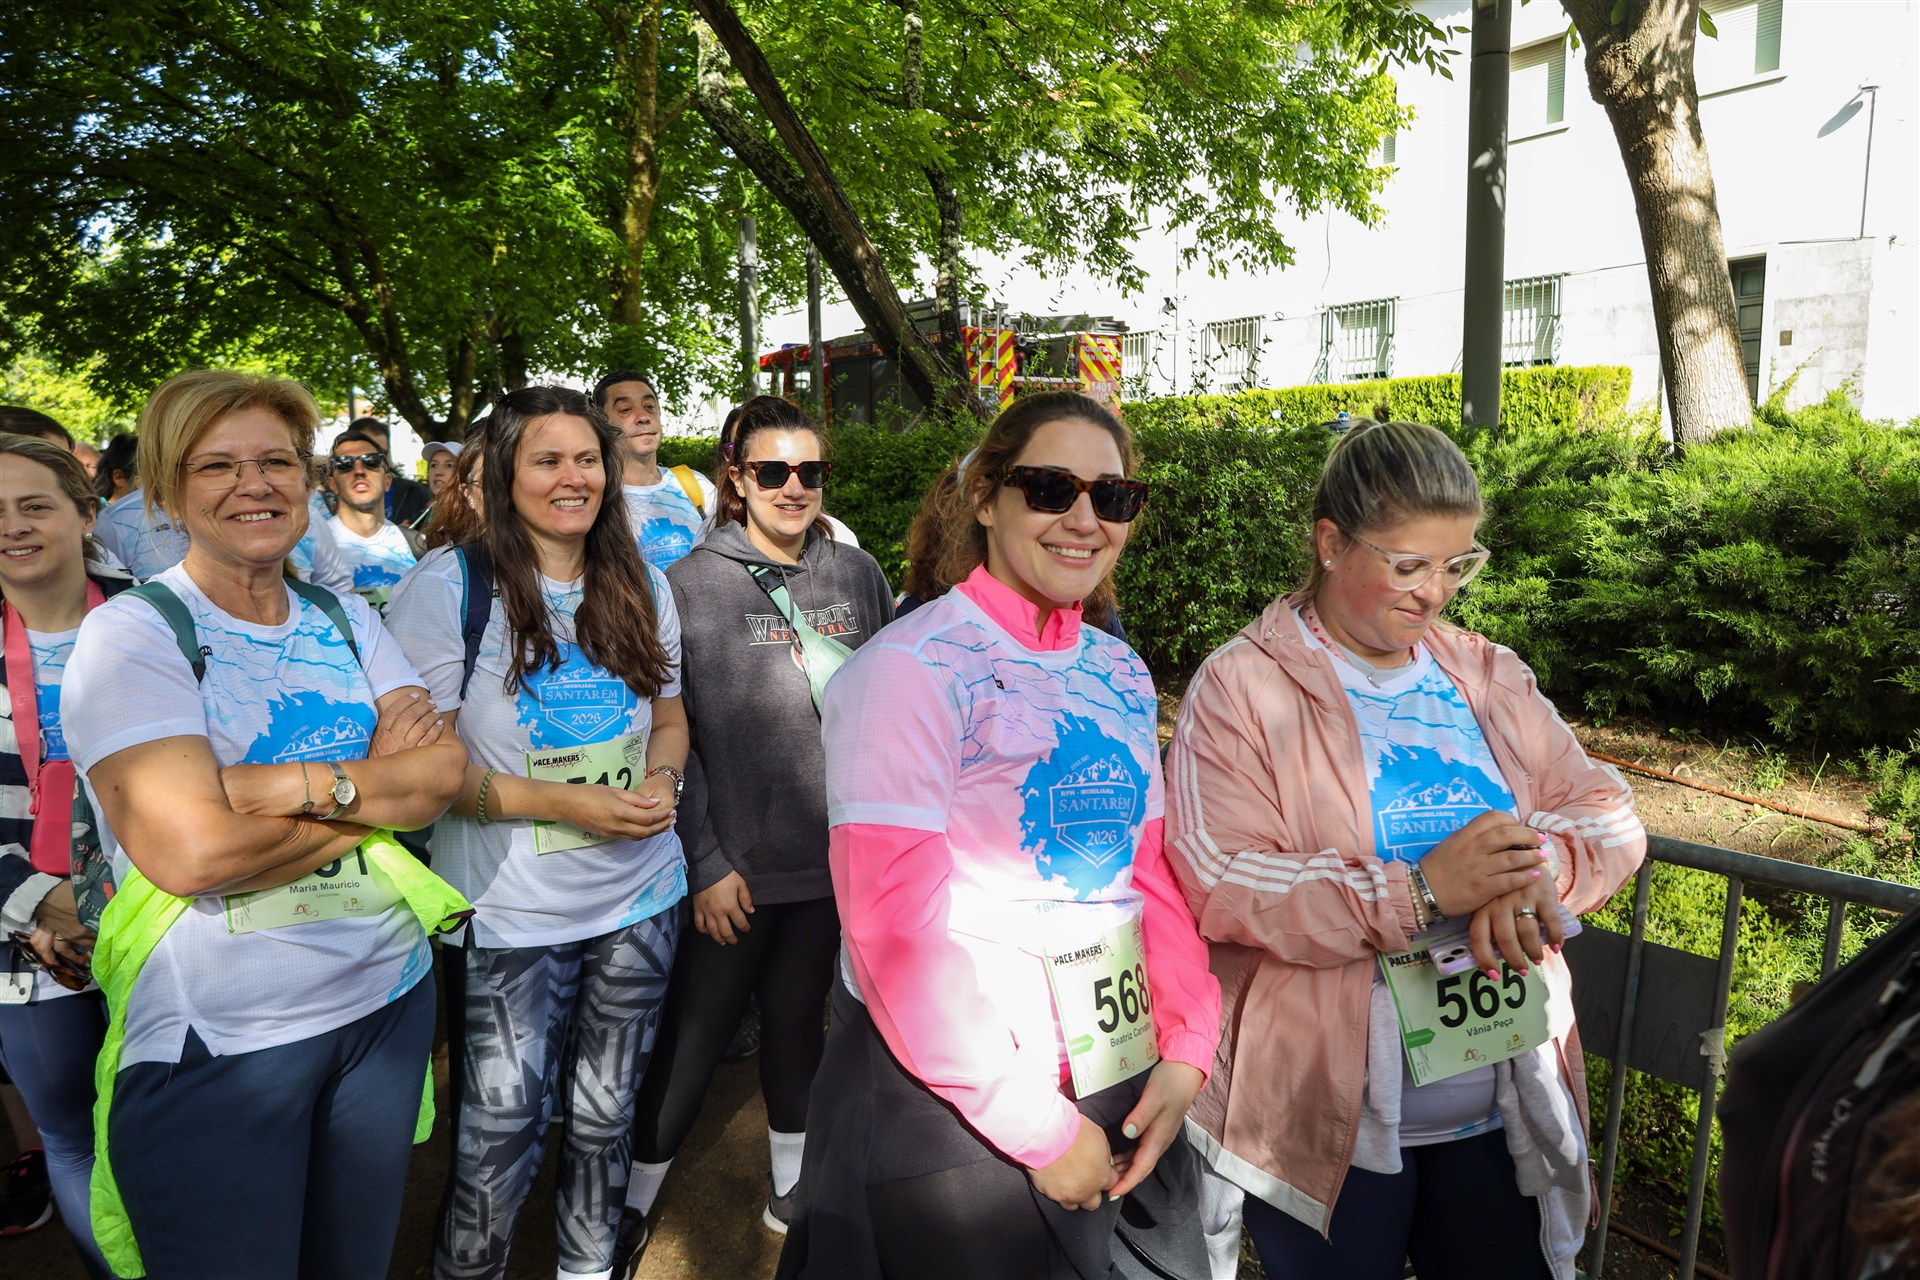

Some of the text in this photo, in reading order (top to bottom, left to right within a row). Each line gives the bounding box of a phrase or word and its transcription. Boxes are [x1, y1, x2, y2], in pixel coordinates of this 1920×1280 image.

[829, 346, 859, 359] SAPADORES
[1091, 382, 1111, 392] 1401
[746, 606, 858, 642] WILLMSBURG
[817, 622, 846, 636] ORK
[546, 687, 618, 701] SANTARÉM
[571, 713, 601, 725] 2026
[1058, 794, 1131, 813] SANTARÉM
[1390, 815, 1471, 835] SANTARÉ
[1086, 830, 1117, 847] 2026
[289, 879, 361, 895] Maria Maurício
[1094, 963, 1150, 1034] 568
[1437, 963, 1527, 1028] 565
[1466, 1017, 1515, 1037] Vânia Peça
[1110, 1031, 1133, 1048] Beatriz
